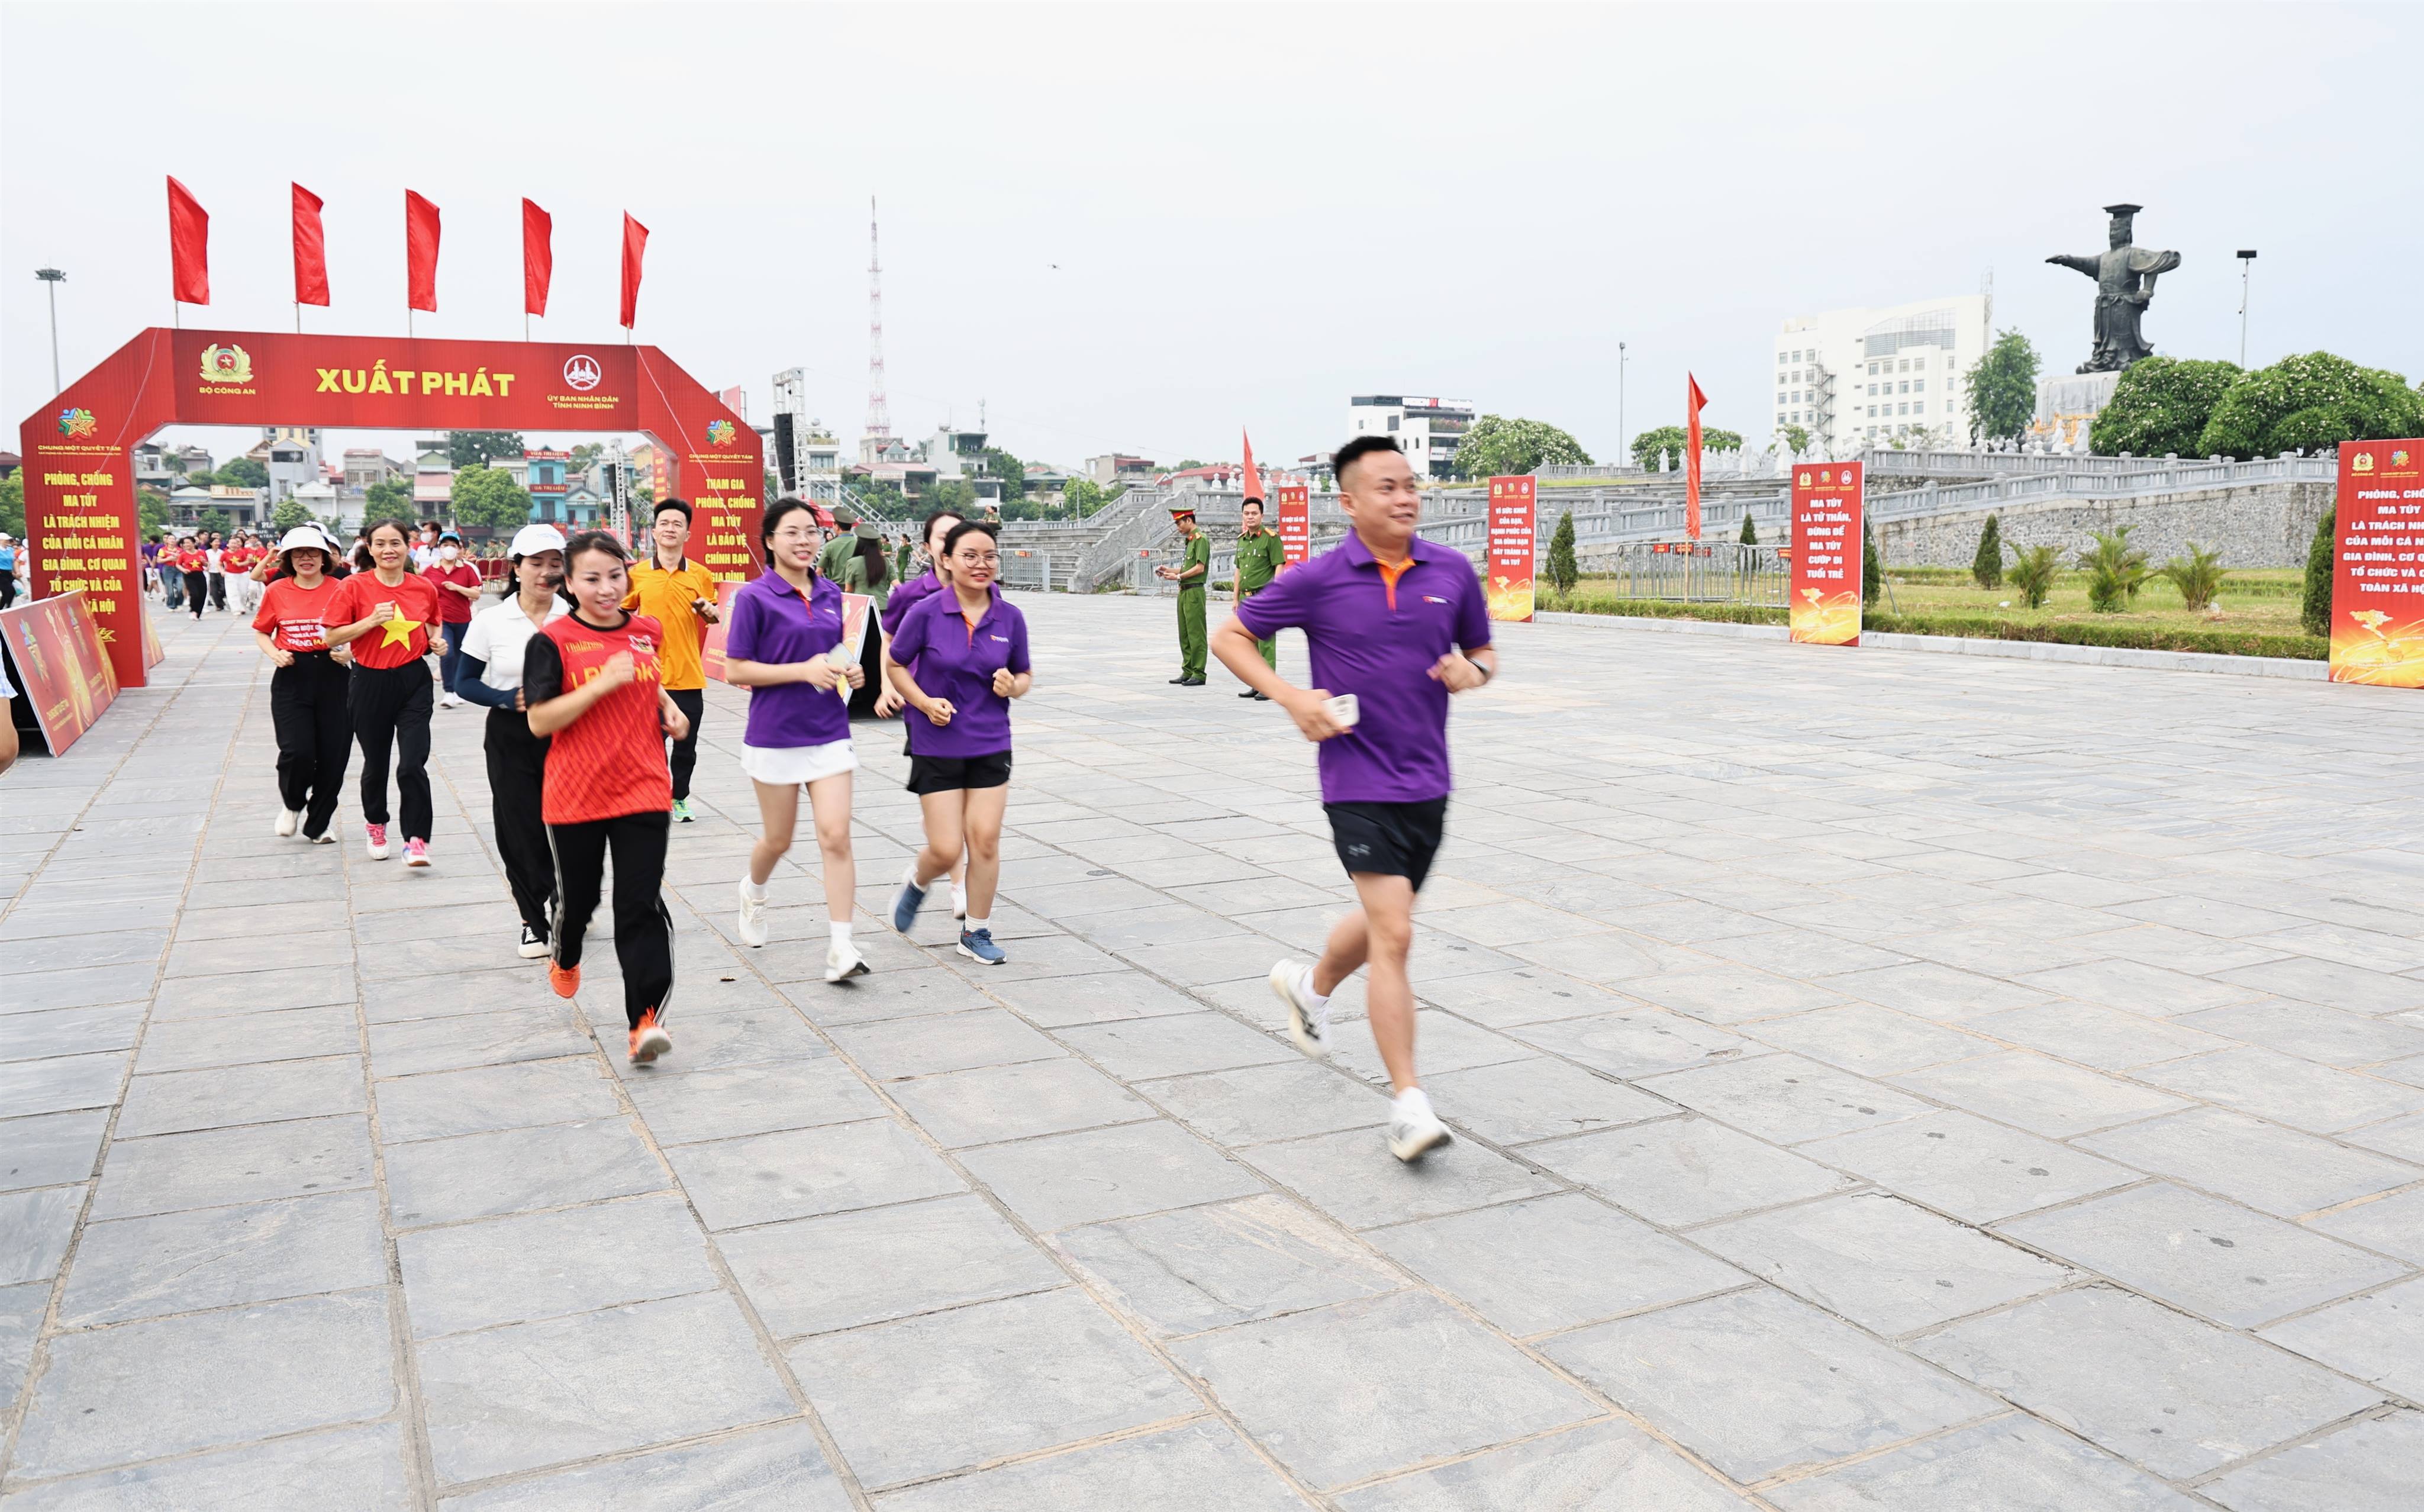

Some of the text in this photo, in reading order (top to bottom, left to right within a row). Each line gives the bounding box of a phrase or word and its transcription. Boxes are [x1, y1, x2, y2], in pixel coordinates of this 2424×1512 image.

[316, 359, 515, 396] XUẤT PHÁT
[199, 386, 212, 395] BỘ
[44, 470, 80, 486] PHÒNG,
[706, 479, 745, 489] THAM GIA
[63, 492, 97, 507] MA TÚY
[2358, 489, 2400, 499] PHÒNG,
[695, 495, 726, 510] PHÒNG,
[1810, 499, 1825, 508] MA
[2377, 504, 2421, 514] MA TÚY
[43, 514, 120, 531] LÀ TRÁCH NHIỆM
[711, 516, 725, 527] MA
[1800, 512, 1811, 522] LÀ
[2351, 521, 2365, 530] LÀ
[2368, 521, 2405, 530] TRÁCH
[42, 533, 62, 549] CỦA
[83, 535, 96, 549] CÁ
[97, 535, 124, 549] NHÂN
[707, 533, 717, 546] LÀ
[2345, 536, 2368, 546] CỦA
[2396, 536, 2412, 546] CÁ
[705, 552, 731, 564] CHÍNH
[2343, 553, 2362, 561] GIA
[2399, 553, 2415, 562] CƠ
[42, 559, 59, 570] GIA
[88, 557, 101, 570] CƠ
[102, 558, 127, 572] QUAN
[2401, 568, 2416, 577] VÀ
[89, 578, 102, 591] VÀ
[103, 576, 123, 591] CỦA
[2360, 582, 2390, 592] TOÀN
[2393, 583, 2408, 592] XÃ
[99, 598, 115, 615] HỘI
